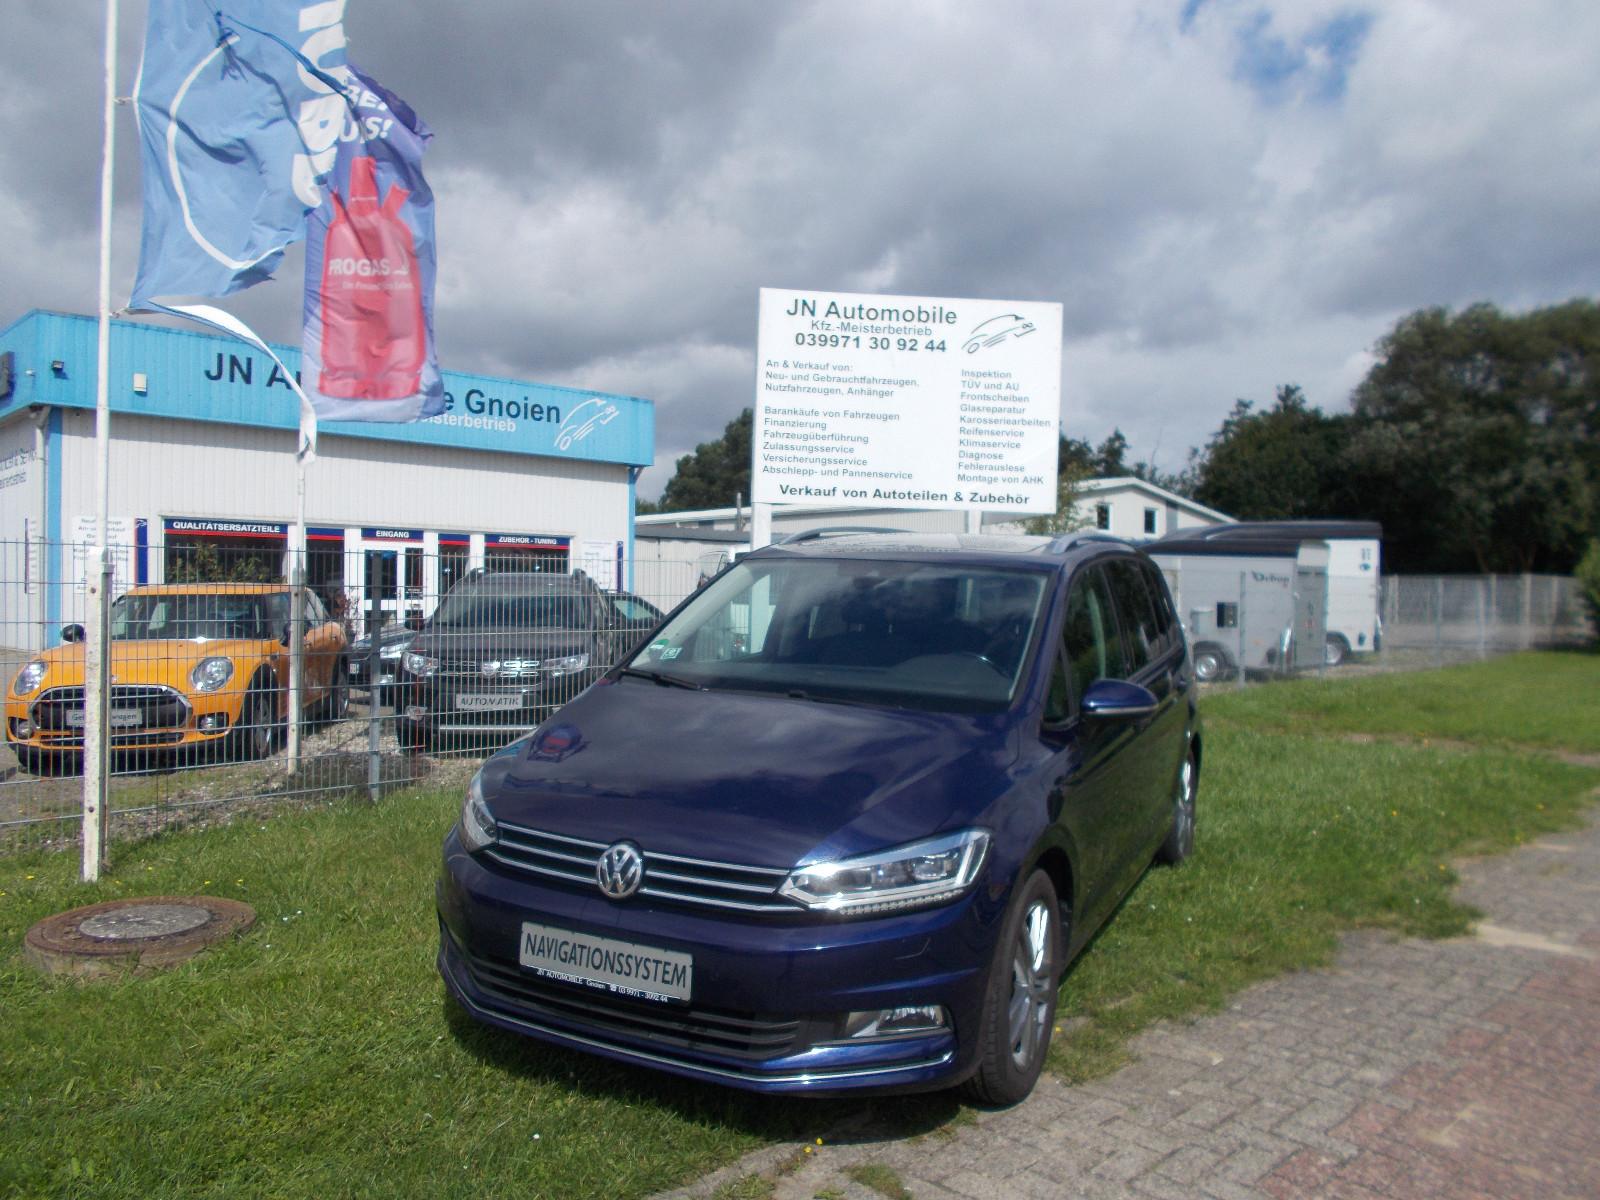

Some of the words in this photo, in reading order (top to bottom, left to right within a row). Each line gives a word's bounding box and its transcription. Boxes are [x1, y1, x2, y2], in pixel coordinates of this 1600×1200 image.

[787, 298, 816, 317] JN
[825, 300, 958, 324] Automobile
[795, 332, 860, 349] 039971
[869, 337, 890, 350] 30
[897, 338, 918, 351] 92
[925, 339, 947, 352] 44
[203, 353, 252, 385] JN
[766, 359, 779, 368] An
[782, 360, 789, 368] &
[792, 360, 829, 371] Verkauf
[765, 371, 788, 380] Neu-
[791, 373, 809, 382] und
[961, 369, 1012, 380] Inspektion
[961, 378, 981, 389] TÜV
[984, 382, 1002, 390] und
[847, 386, 894, 399] Anhänger
[960, 391, 1030, 403] Frontscheiben
[465, 388, 561, 424] Gnoien
[960, 403, 1026, 414] Glasreparatur
[764, 406, 820, 418] Barankäufe
[823, 410, 840, 418] von
[843, 409, 900, 422] Fahrzeugen
[764, 418, 827, 431] Finanzierung
[960, 415, 1051, 427] Karosseriearbeiten
[763, 430, 869, 444] Fahrzeugüberführung
[959, 427, 1025, 437] Reifenservice
[763, 442, 855, 455] Zulassungsservice
[959, 439, 1021, 449] Klimaservice
[763, 454, 868, 467] Versicherungsservice
[958, 450, 1004, 461] Diagnose
[763, 466, 818, 477] Abschlepp-
[821, 468, 839, 477] und
[842, 469, 913, 480] Pannenservice
[958, 462, 1025, 472] Fehlerauslese
[957, 474, 998, 484] Montage
[1001, 476, 1019, 484] von
[1022, 476, 1044, 484] AHK
[779, 484, 837, 497] Verkauf
[843, 489, 868, 498] von
[873, 488, 948, 502] Autoteilen
[954, 491, 964, 502] &
[969, 492, 1030, 504] Zubehör
[376, 530, 409, 539] EINGANG
[525, 932, 687, 989] NAVIGATIONSSYSTEM
